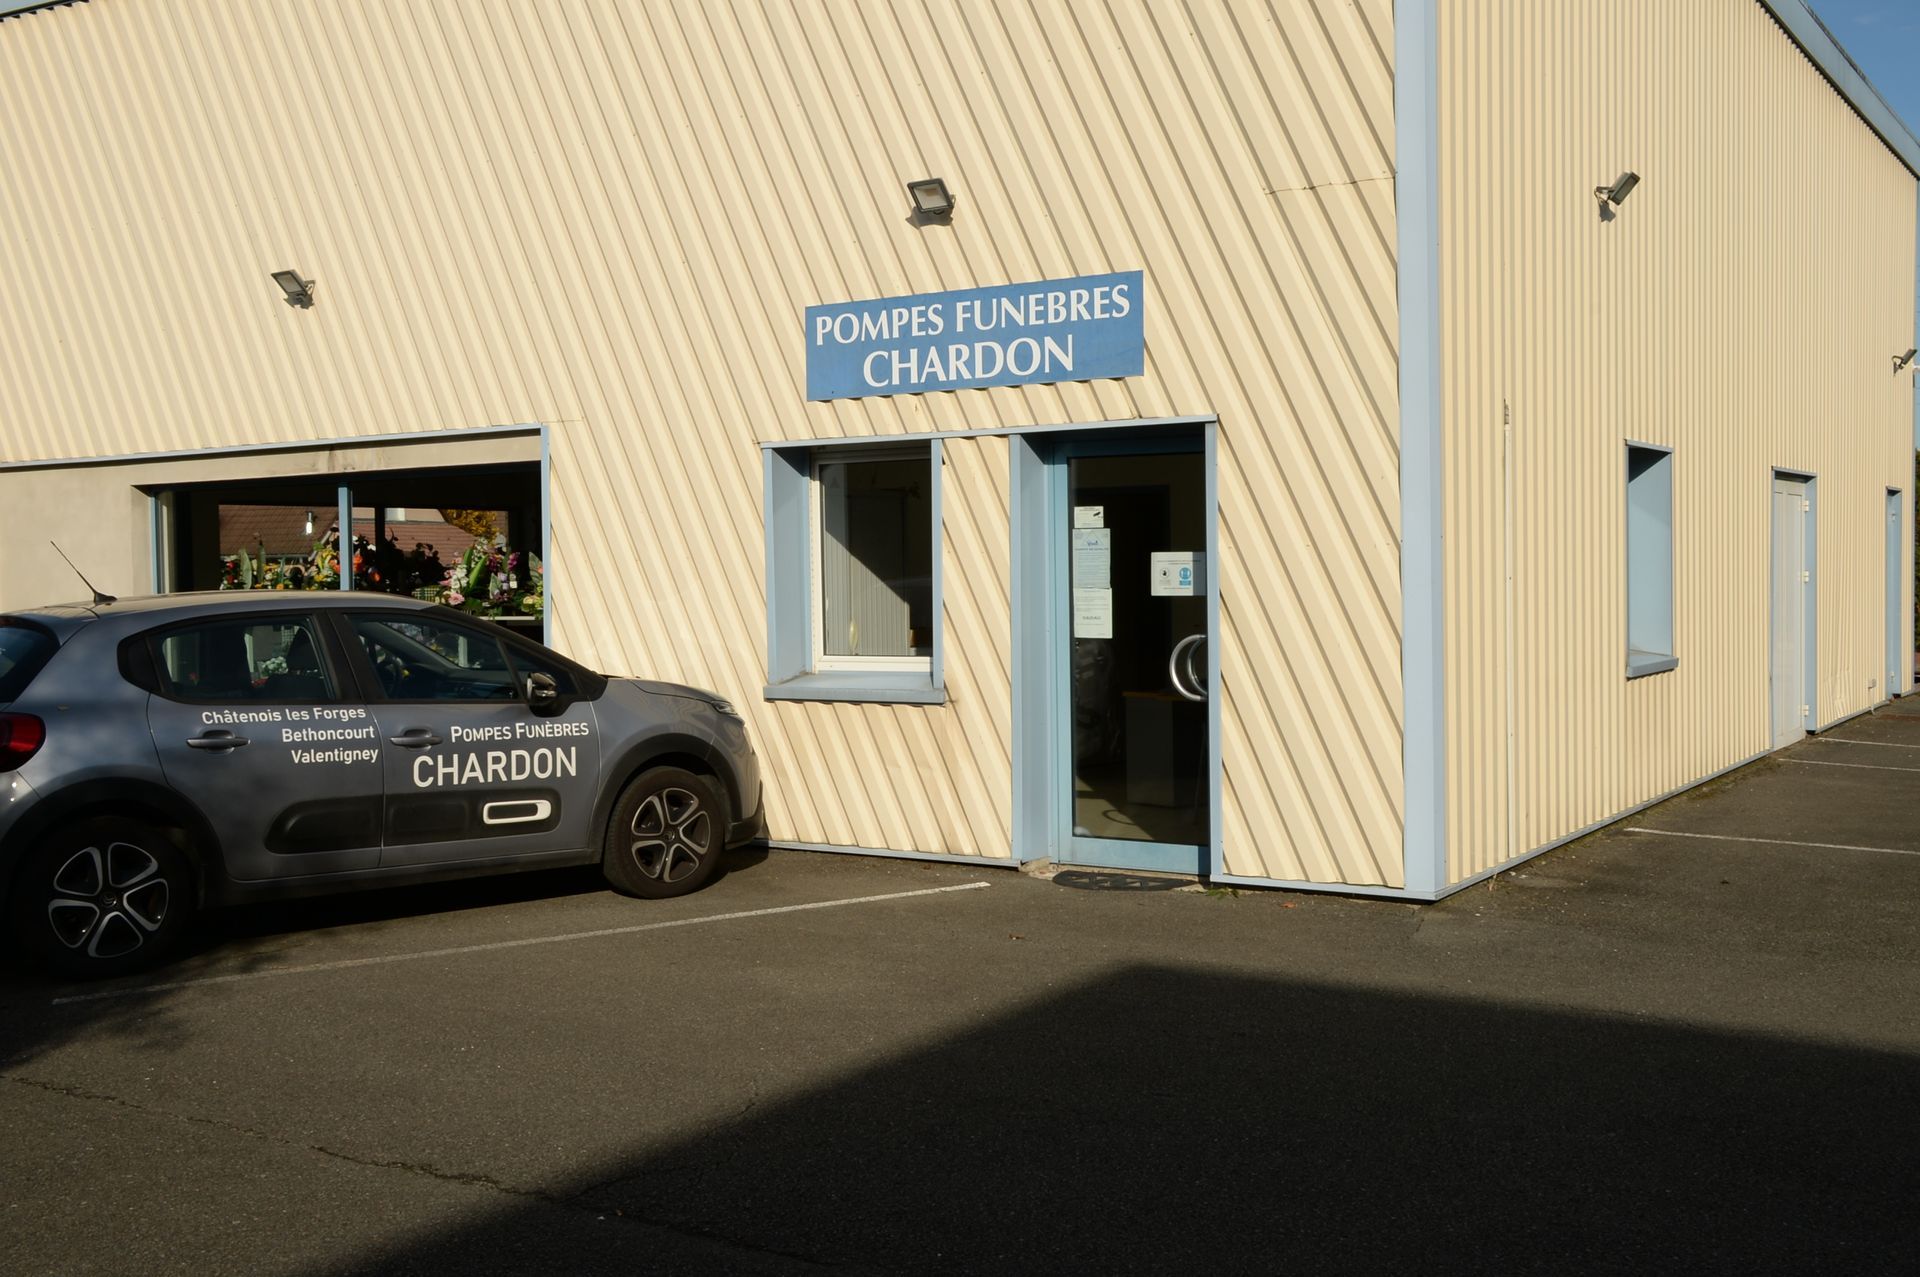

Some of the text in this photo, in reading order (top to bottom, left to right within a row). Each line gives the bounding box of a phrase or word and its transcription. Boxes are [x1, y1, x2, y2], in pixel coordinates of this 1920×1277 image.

[816, 284, 1130, 346] POMPES FUNEBRES
[863, 334, 1074, 388] CHARDON
[202, 707, 366, 724] Châtenois les Forges
[282, 726, 375, 742] Bethoncourt
[451, 721, 589, 743] POMPES FUNÈBRES
[291, 748, 378, 764] Valentigney
[413, 746, 577, 788] CHARDON
